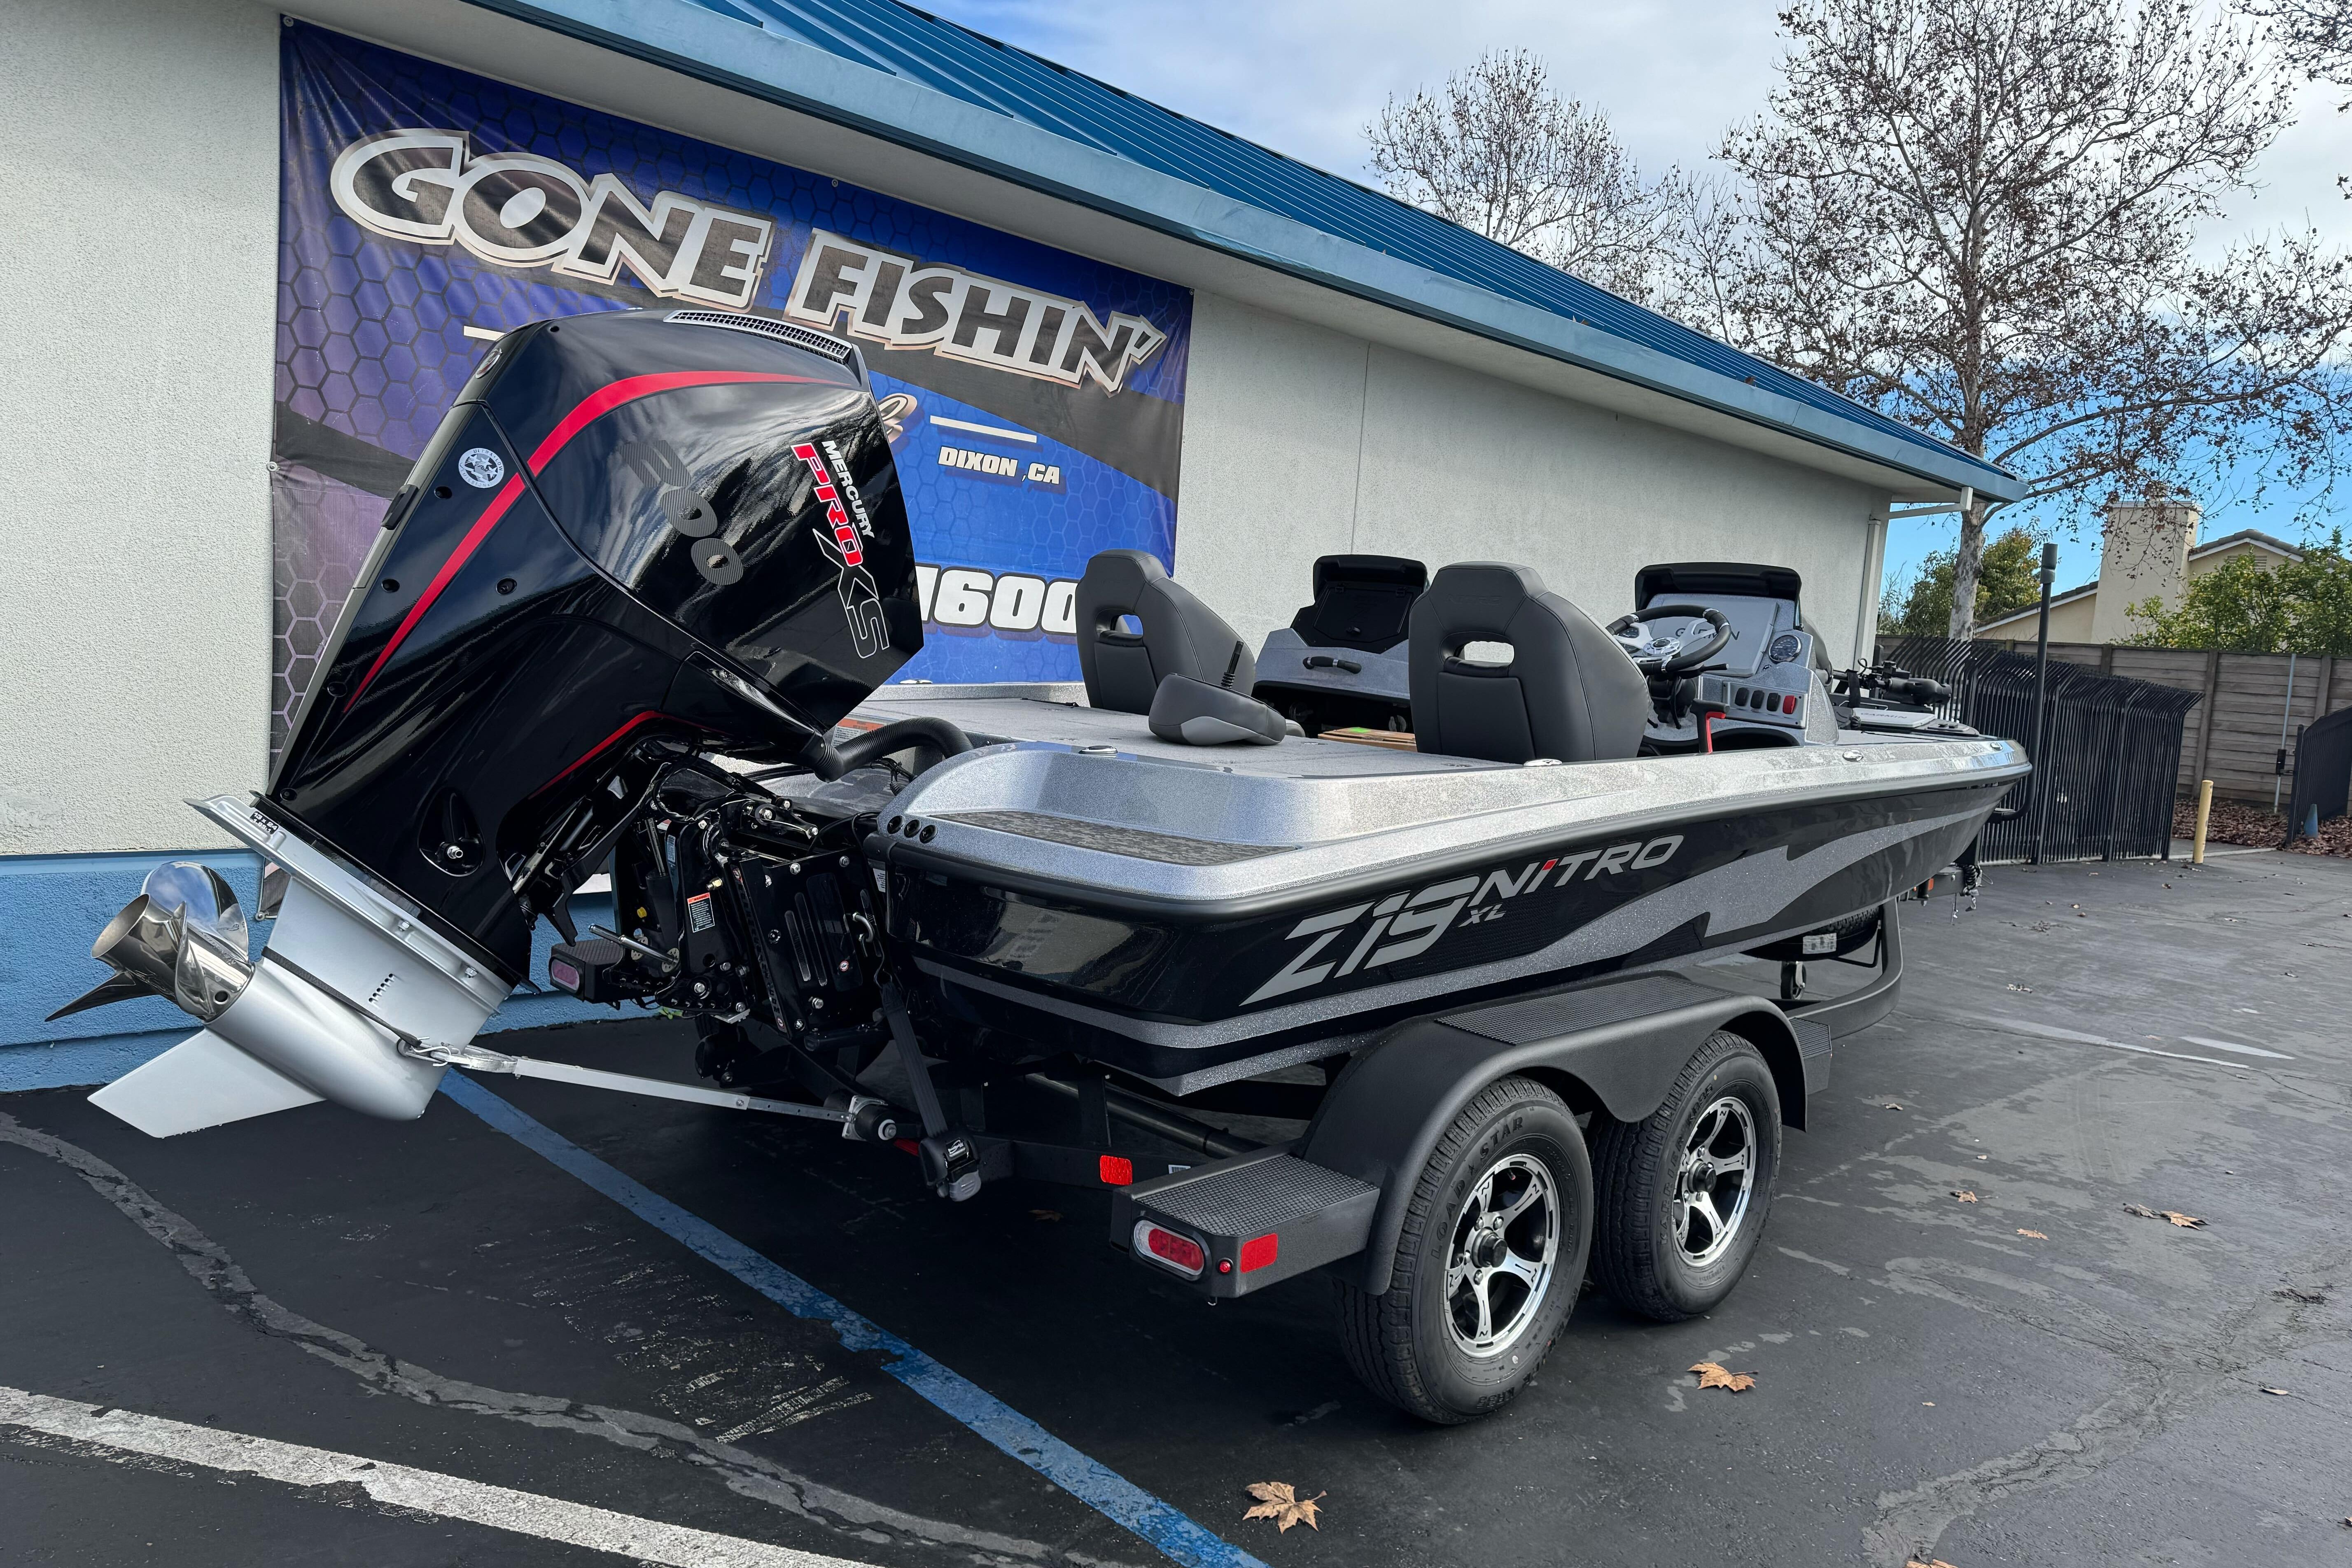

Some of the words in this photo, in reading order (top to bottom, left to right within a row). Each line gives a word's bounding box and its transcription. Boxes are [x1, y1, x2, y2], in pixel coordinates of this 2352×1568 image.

[331, 128, 774, 313] GONE
[618, 439, 744, 586] 200
[790, 442, 863, 567] PRO
[821, 440, 875, 538] MERCURY
[938, 446, 1018, 477] DIXON
[812, 523, 890, 659] XS
[267, 821, 278, 830] 24
[1239, 875, 1481, 1006] Z19
[1467, 834, 1685, 907] NITRO
[1458, 904, 1506, 928] XL
[1431, 1179, 1466, 1259] LOAD
[1479, 1116, 1524, 1160] STAR
